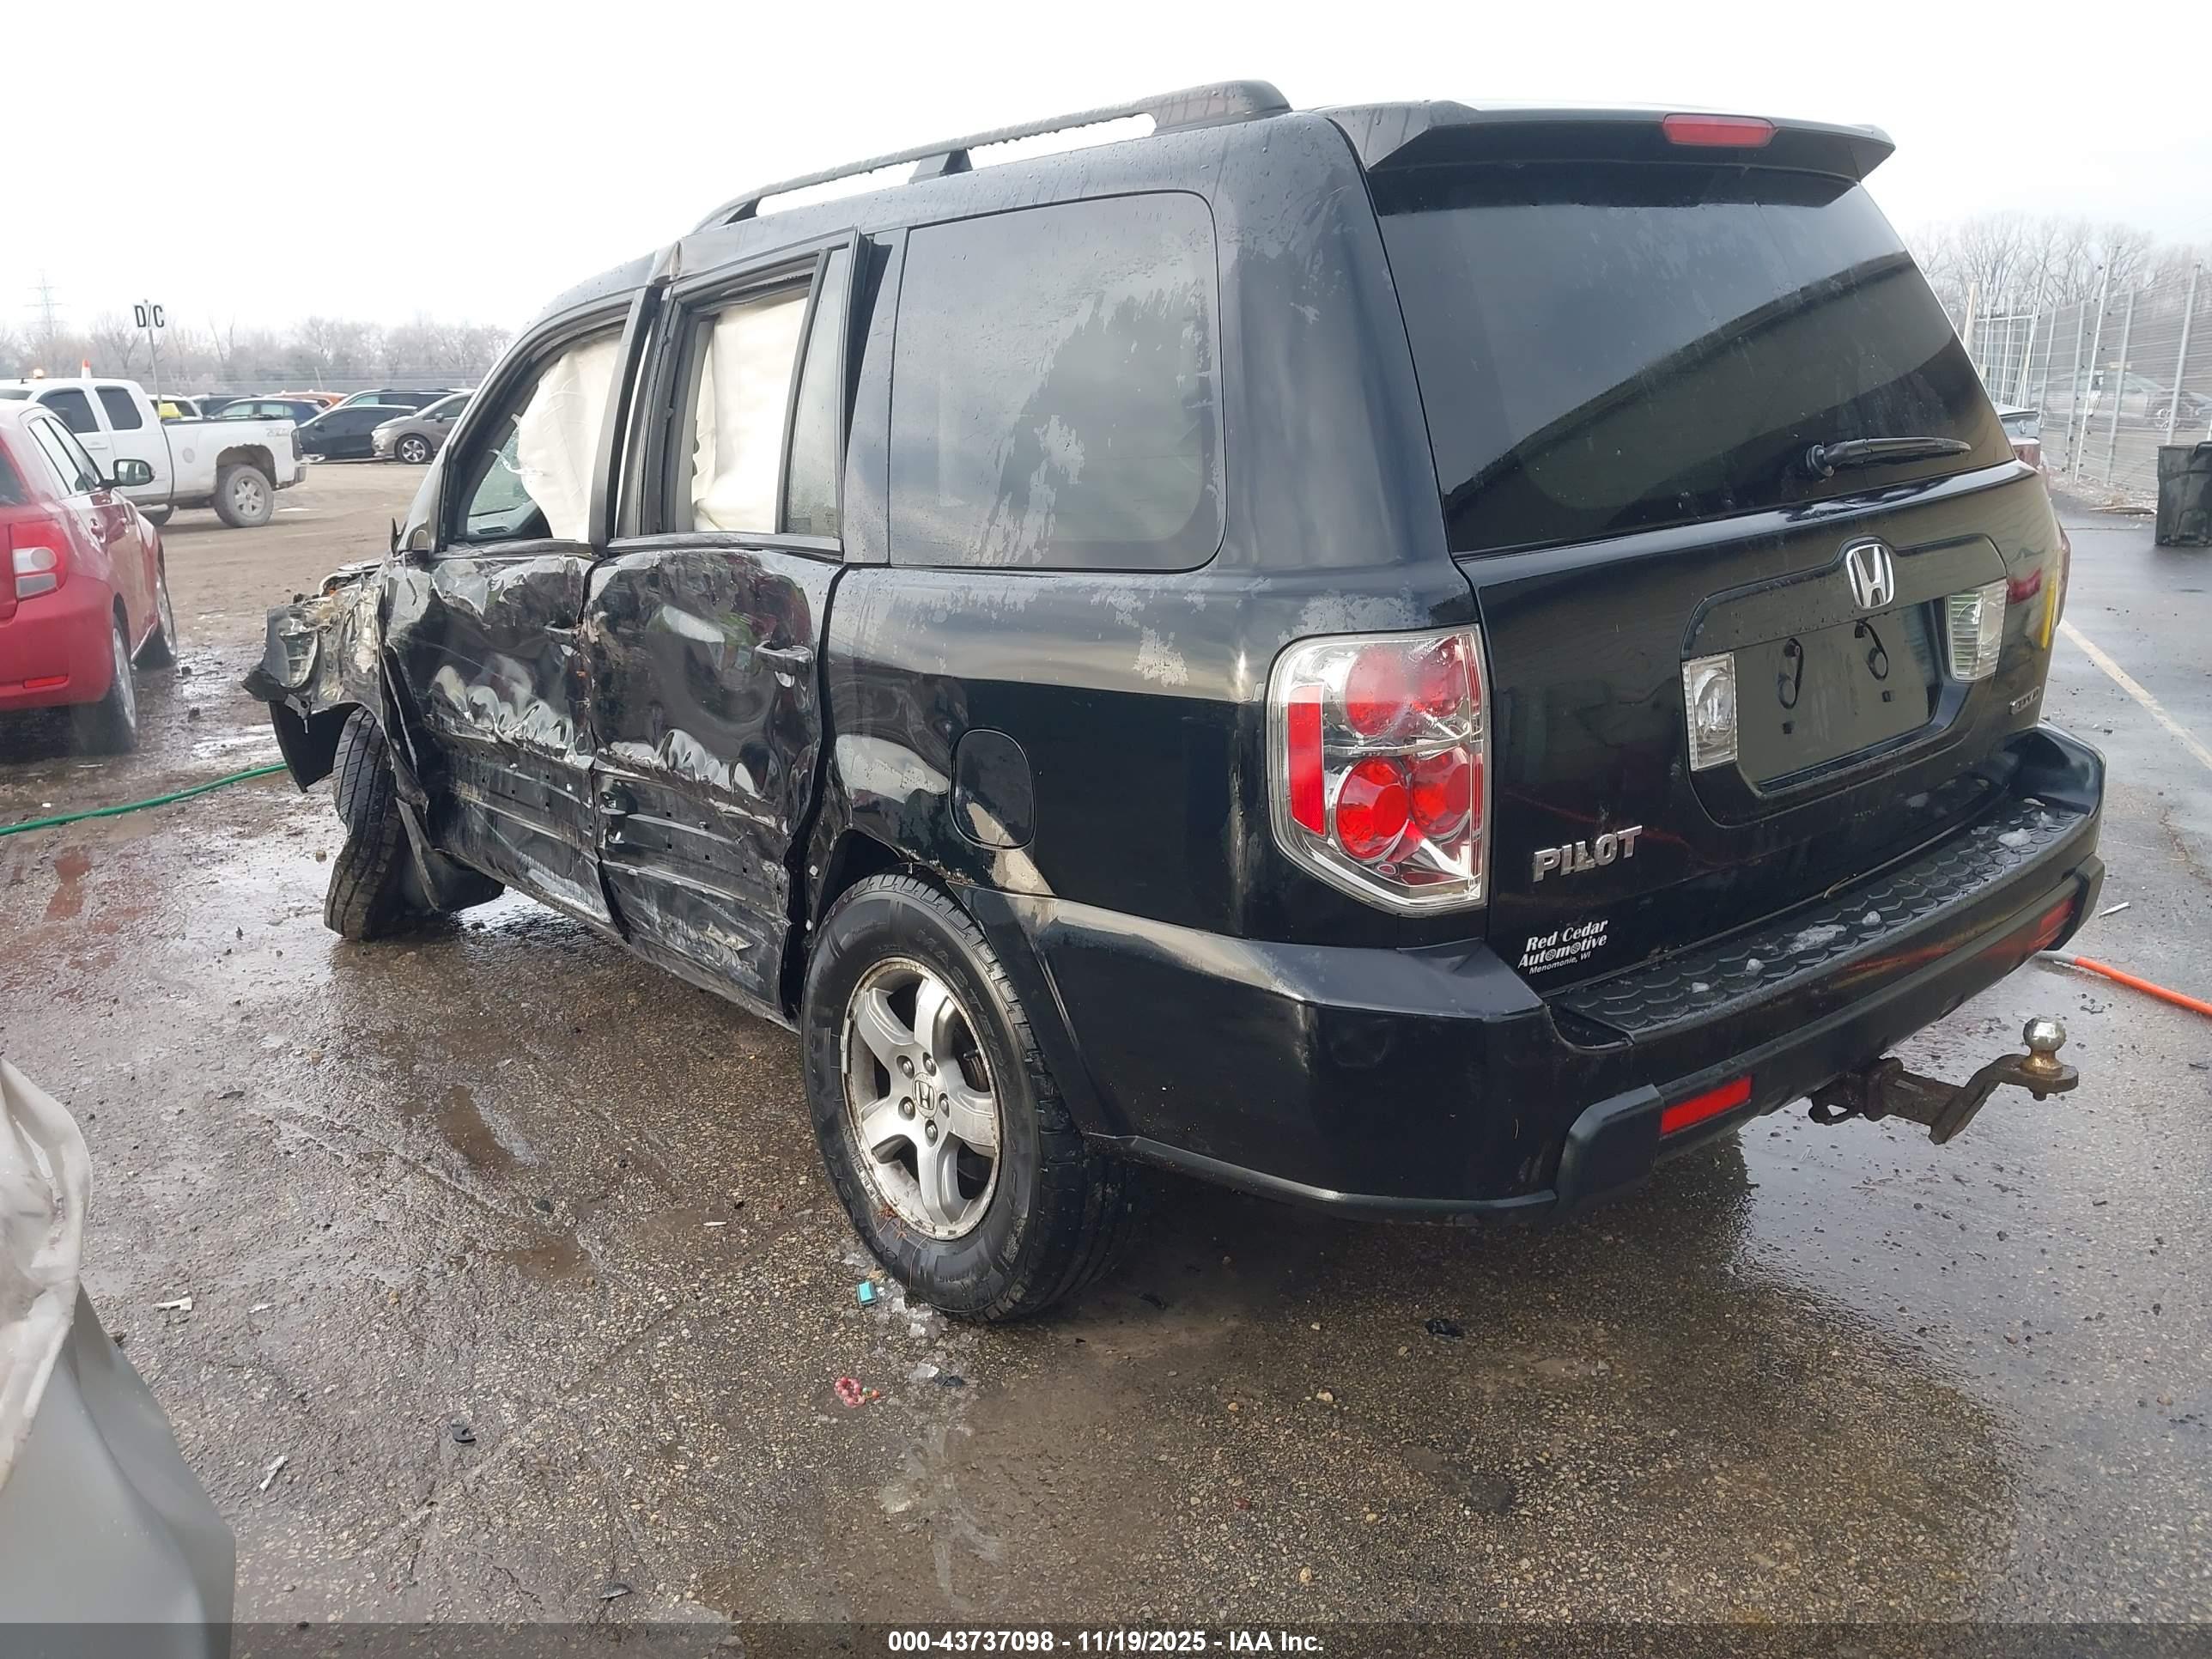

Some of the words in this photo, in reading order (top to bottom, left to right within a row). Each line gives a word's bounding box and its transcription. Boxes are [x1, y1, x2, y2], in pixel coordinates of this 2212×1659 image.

[134, 304, 164, 328] D/C
[1533, 824, 1643, 883] PILOT
[1517, 934, 1607, 969] Automotive
[1525, 931, 1559, 952] Red
[1563, 920, 1609, 942] Cedar
[1528, 956, 1578, 975] Menomonie,
[1580, 951, 1592, 961] WI
